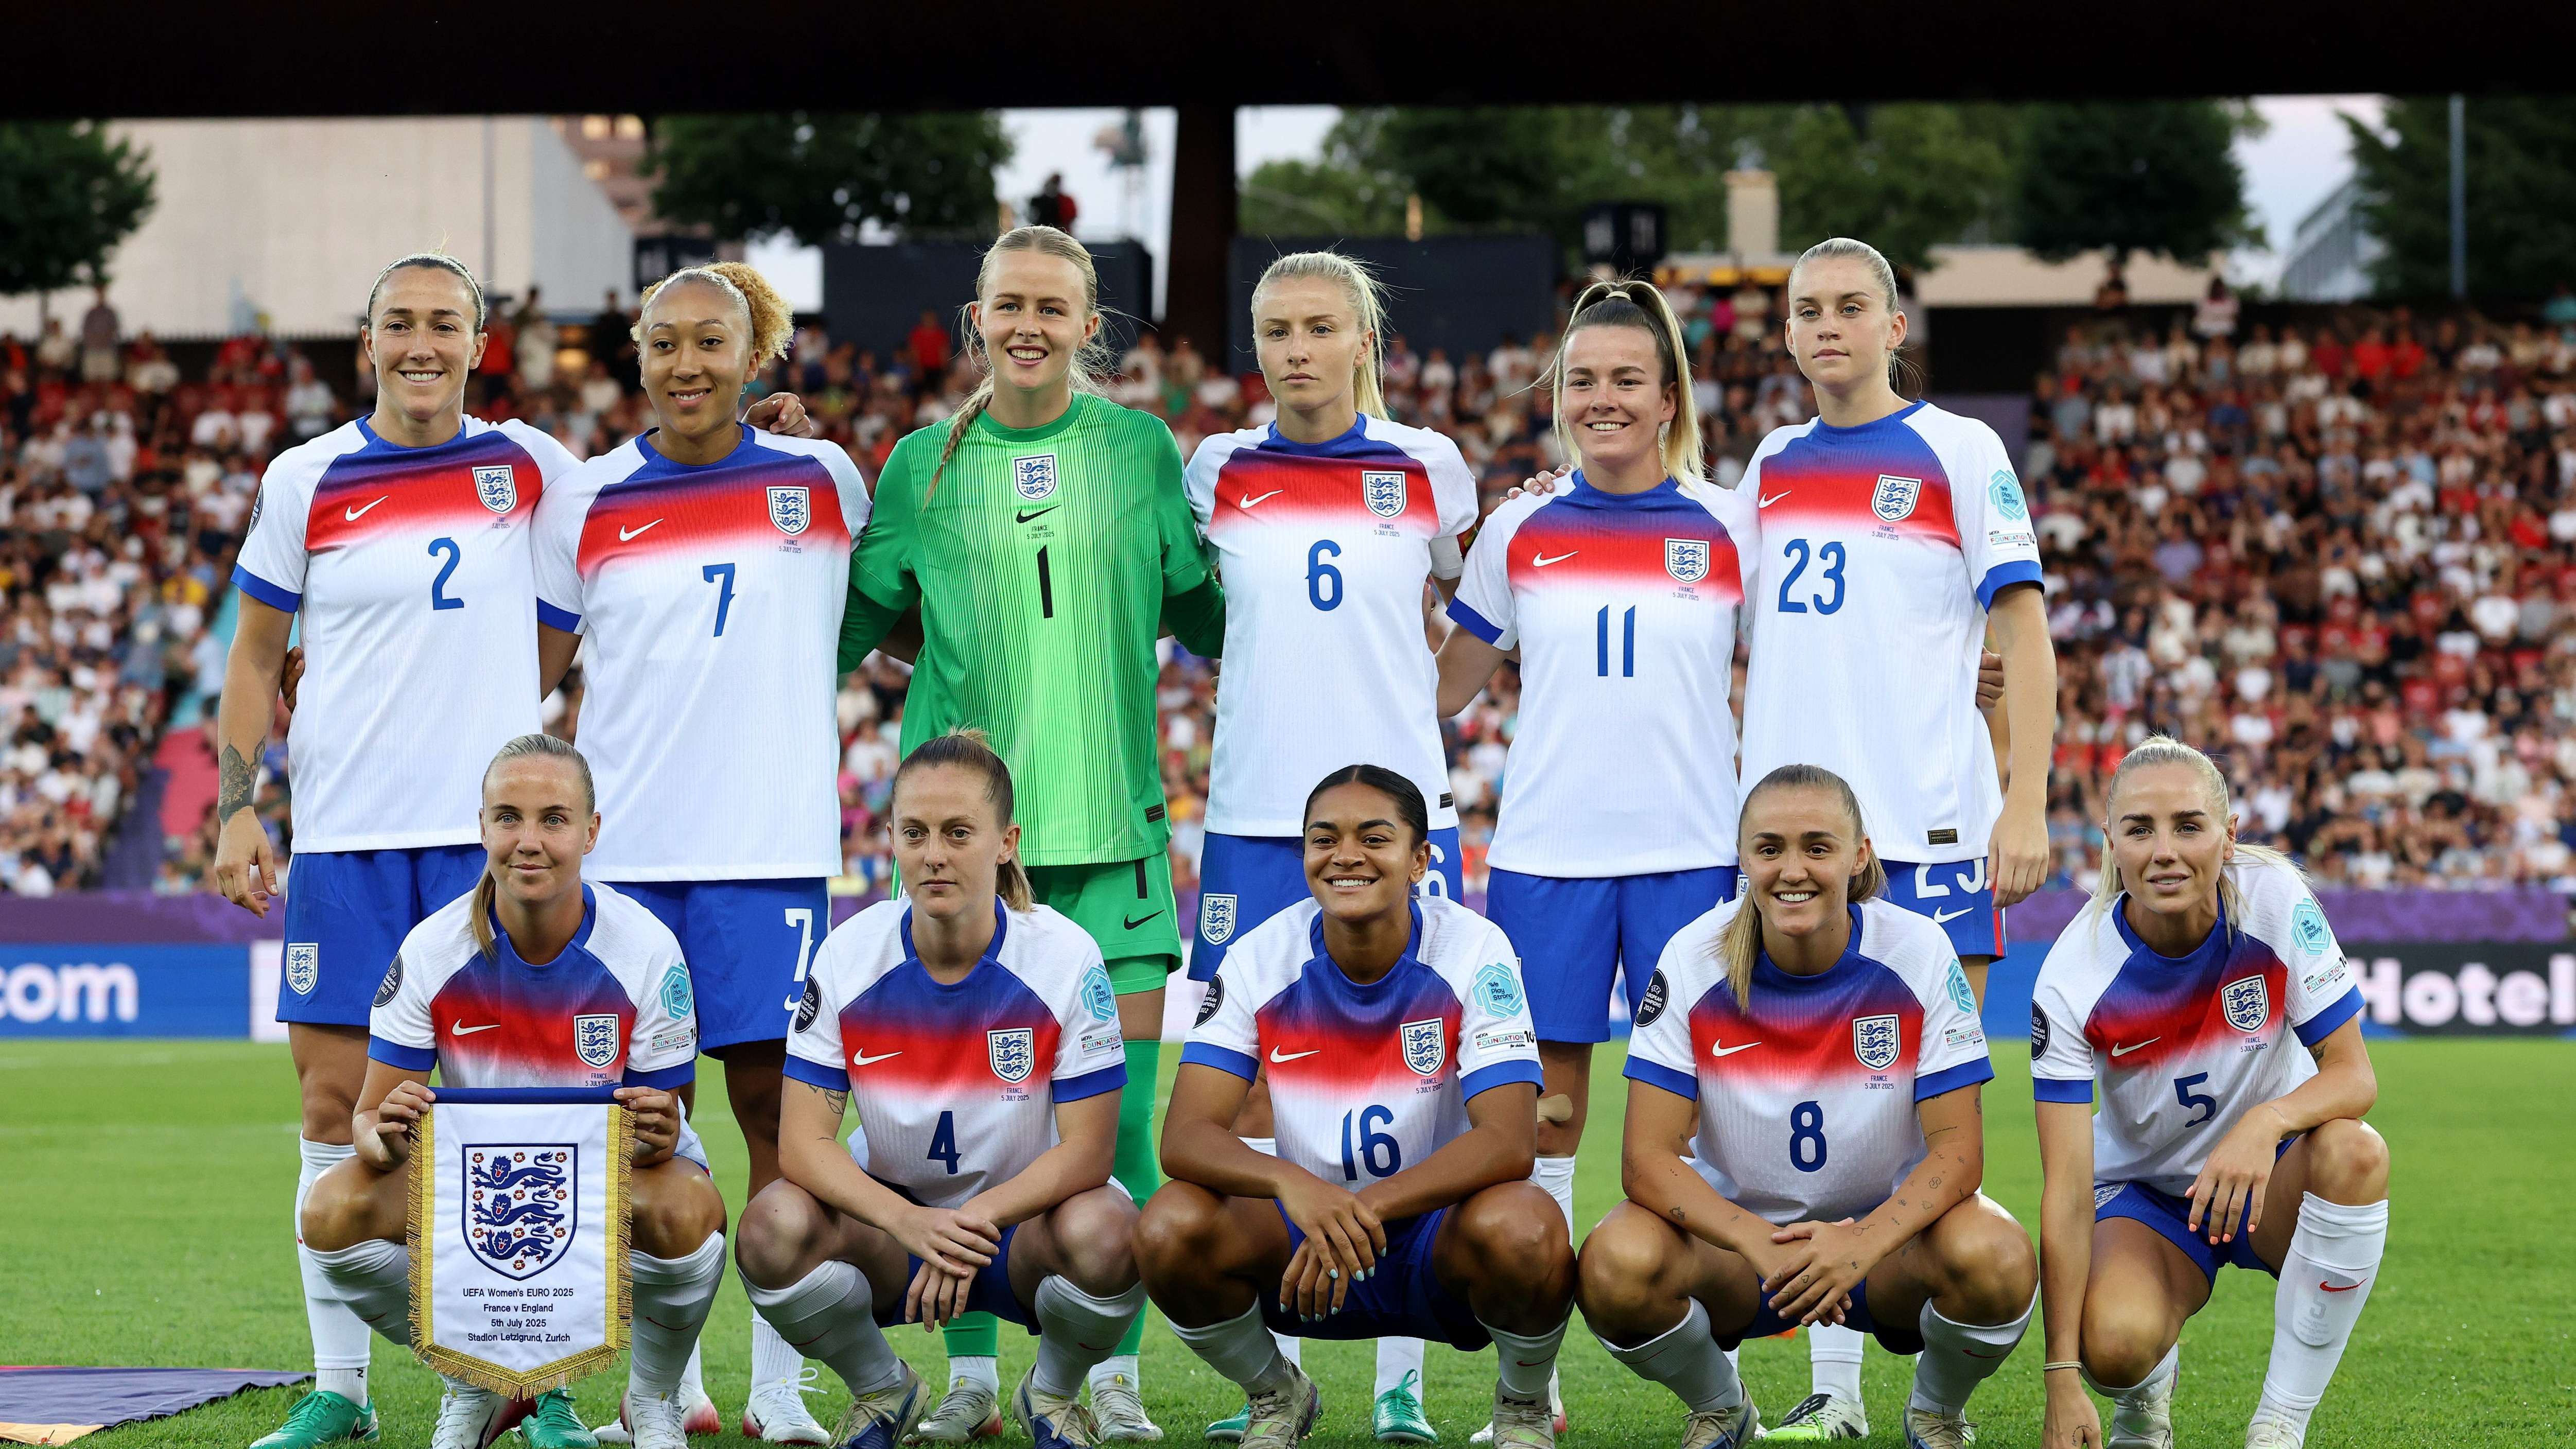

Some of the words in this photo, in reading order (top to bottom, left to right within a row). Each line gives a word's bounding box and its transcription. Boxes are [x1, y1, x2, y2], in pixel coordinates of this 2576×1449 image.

[1879, 525, 1895, 533] FRANCE
[428, 537, 464, 610] 2
[702, 563, 736, 637] 7
[1037, 544, 1053, 619] 1
[1305, 539, 1343, 612] 6
[1778, 538, 1846, 615] 23
[1597, 604, 1635, 677] 11
[785, 908, 814, 982] 7
[2305, 923, 2316, 933] Play
[2308, 926, 2323, 939] Strong
[0, 962, 139, 1023] om
[1643, 1004, 1655, 1013] 2022
[2347, 953, 2576, 1026] Hotel
[652, 1034, 689, 1049] FOUNDATION
[1082, 1035, 1120, 1050] FOUNDATION
[1477, 1034, 1524, 1047] FOUNDATION
[2173, 1071, 2216, 1128] 5
[927, 1110, 962, 1175] 4
[1341, 1105, 1401, 1181] 16
[1789, 1101, 1827, 1173] 8
[463, 1288, 484, 1297] UEFA
[527, 1288, 550, 1297] EURO
[553, 1288, 573, 1297] 2025
[483, 1303, 511, 1312] France
[521, 1303, 553, 1314] England
[491, 1319, 503, 1327] 5th
[507, 1319, 523, 1329] July
[526, 1319, 546, 1327] 2025
